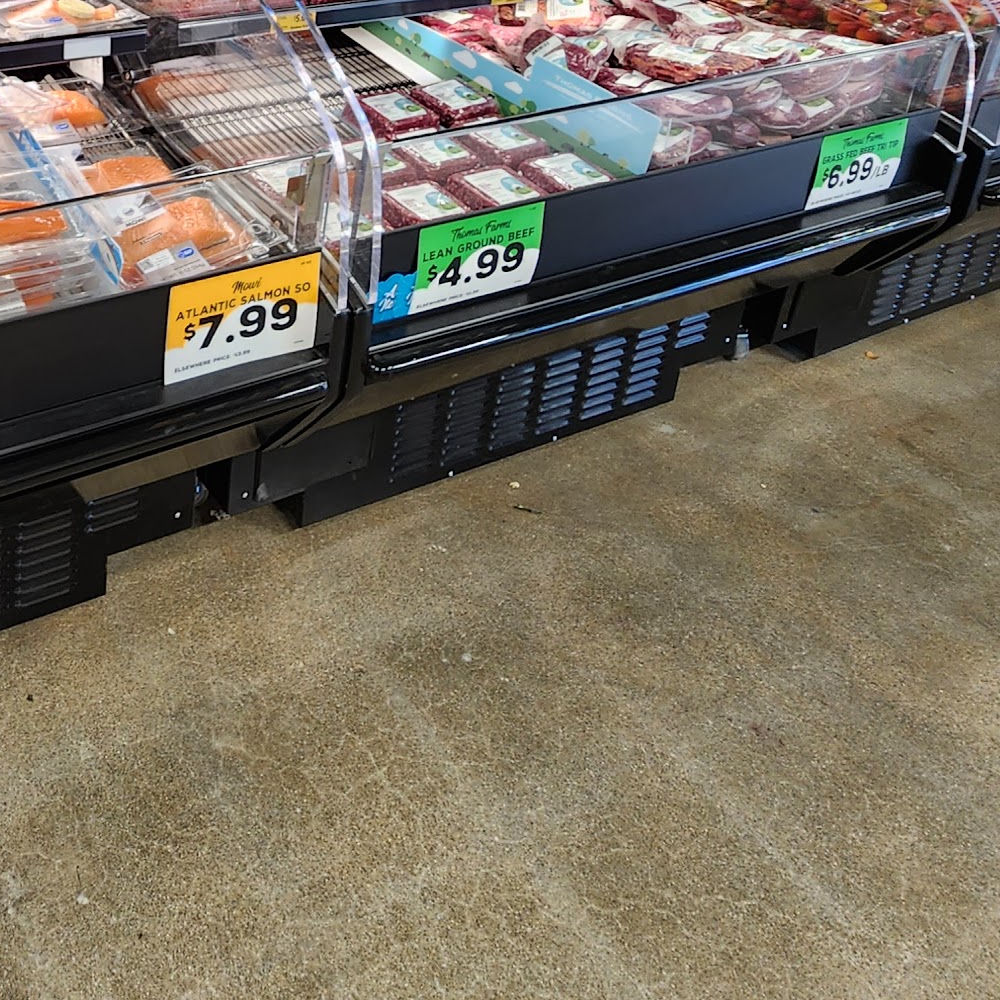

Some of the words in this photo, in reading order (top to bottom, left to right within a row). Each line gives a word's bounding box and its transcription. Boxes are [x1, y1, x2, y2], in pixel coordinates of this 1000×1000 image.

[822, 152, 844, 164] GRASS
[845, 150, 857, 159] FED
[860, 144, 875, 153] BEEF
[877, 142, 887, 150] TRI
[889, 139, 899, 148] TIP
[422, 247, 453, 263] LEAN
[457, 234, 504, 254] GROUND
[508, 227, 535, 244] BEEF
[451, 226, 483, 243] Thomas
[484, 219, 512, 235] Farms
[427, 241, 526, 287] $4.99
[231, 277, 263, 294] Mowi
[175, 298, 237, 321] ATLANTIC
[240, 285, 291, 305] SALMON
[295, 281, 311, 293] SO
[184, 297, 298, 350] $7.99
[174, 359, 211, 373] ELSEWHERE
